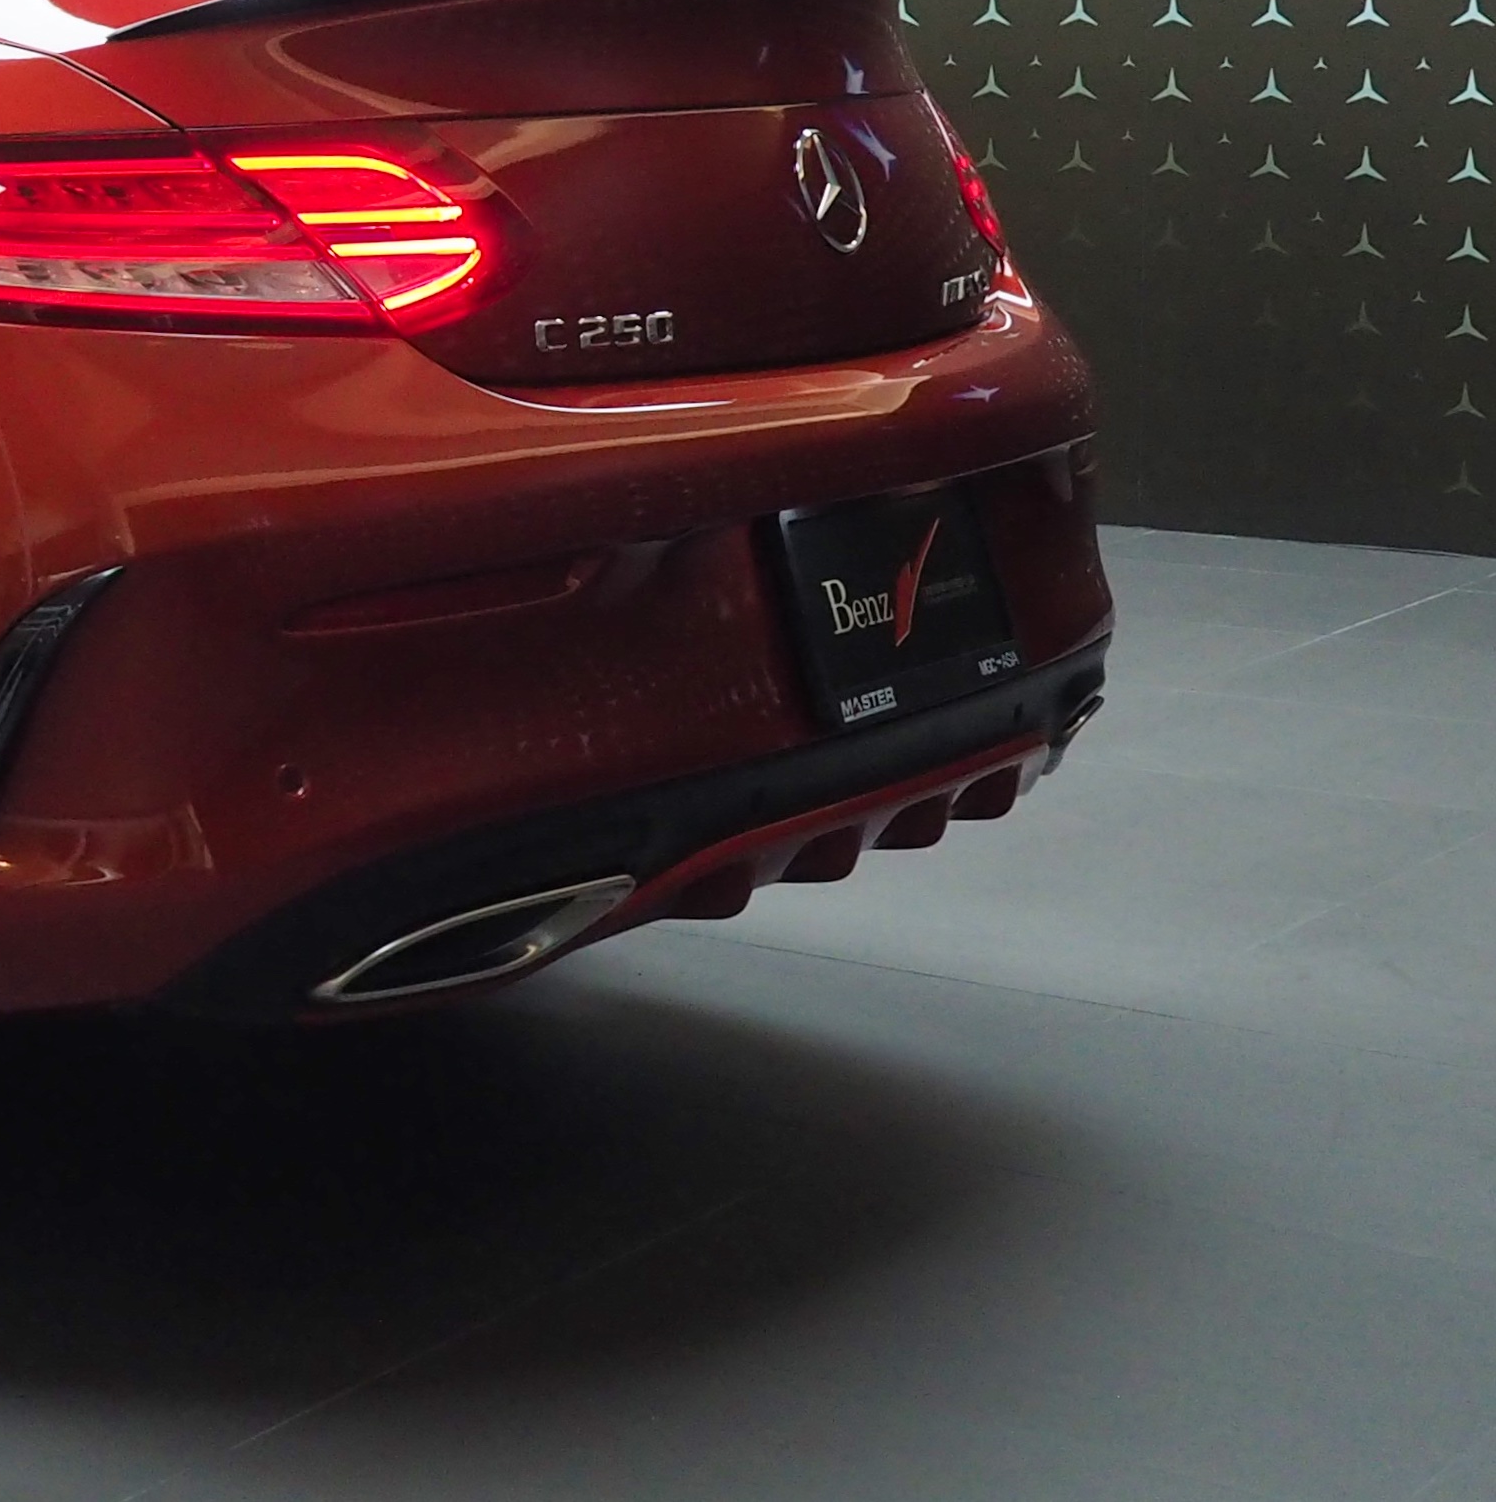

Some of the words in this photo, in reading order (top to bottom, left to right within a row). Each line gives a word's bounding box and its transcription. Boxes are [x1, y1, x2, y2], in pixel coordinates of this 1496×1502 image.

[534, 318, 568, 352] C
[578, 310, 673, 349] 250
[821, 578, 894, 635] Benz
[840, 686, 897, 720] MASTER
